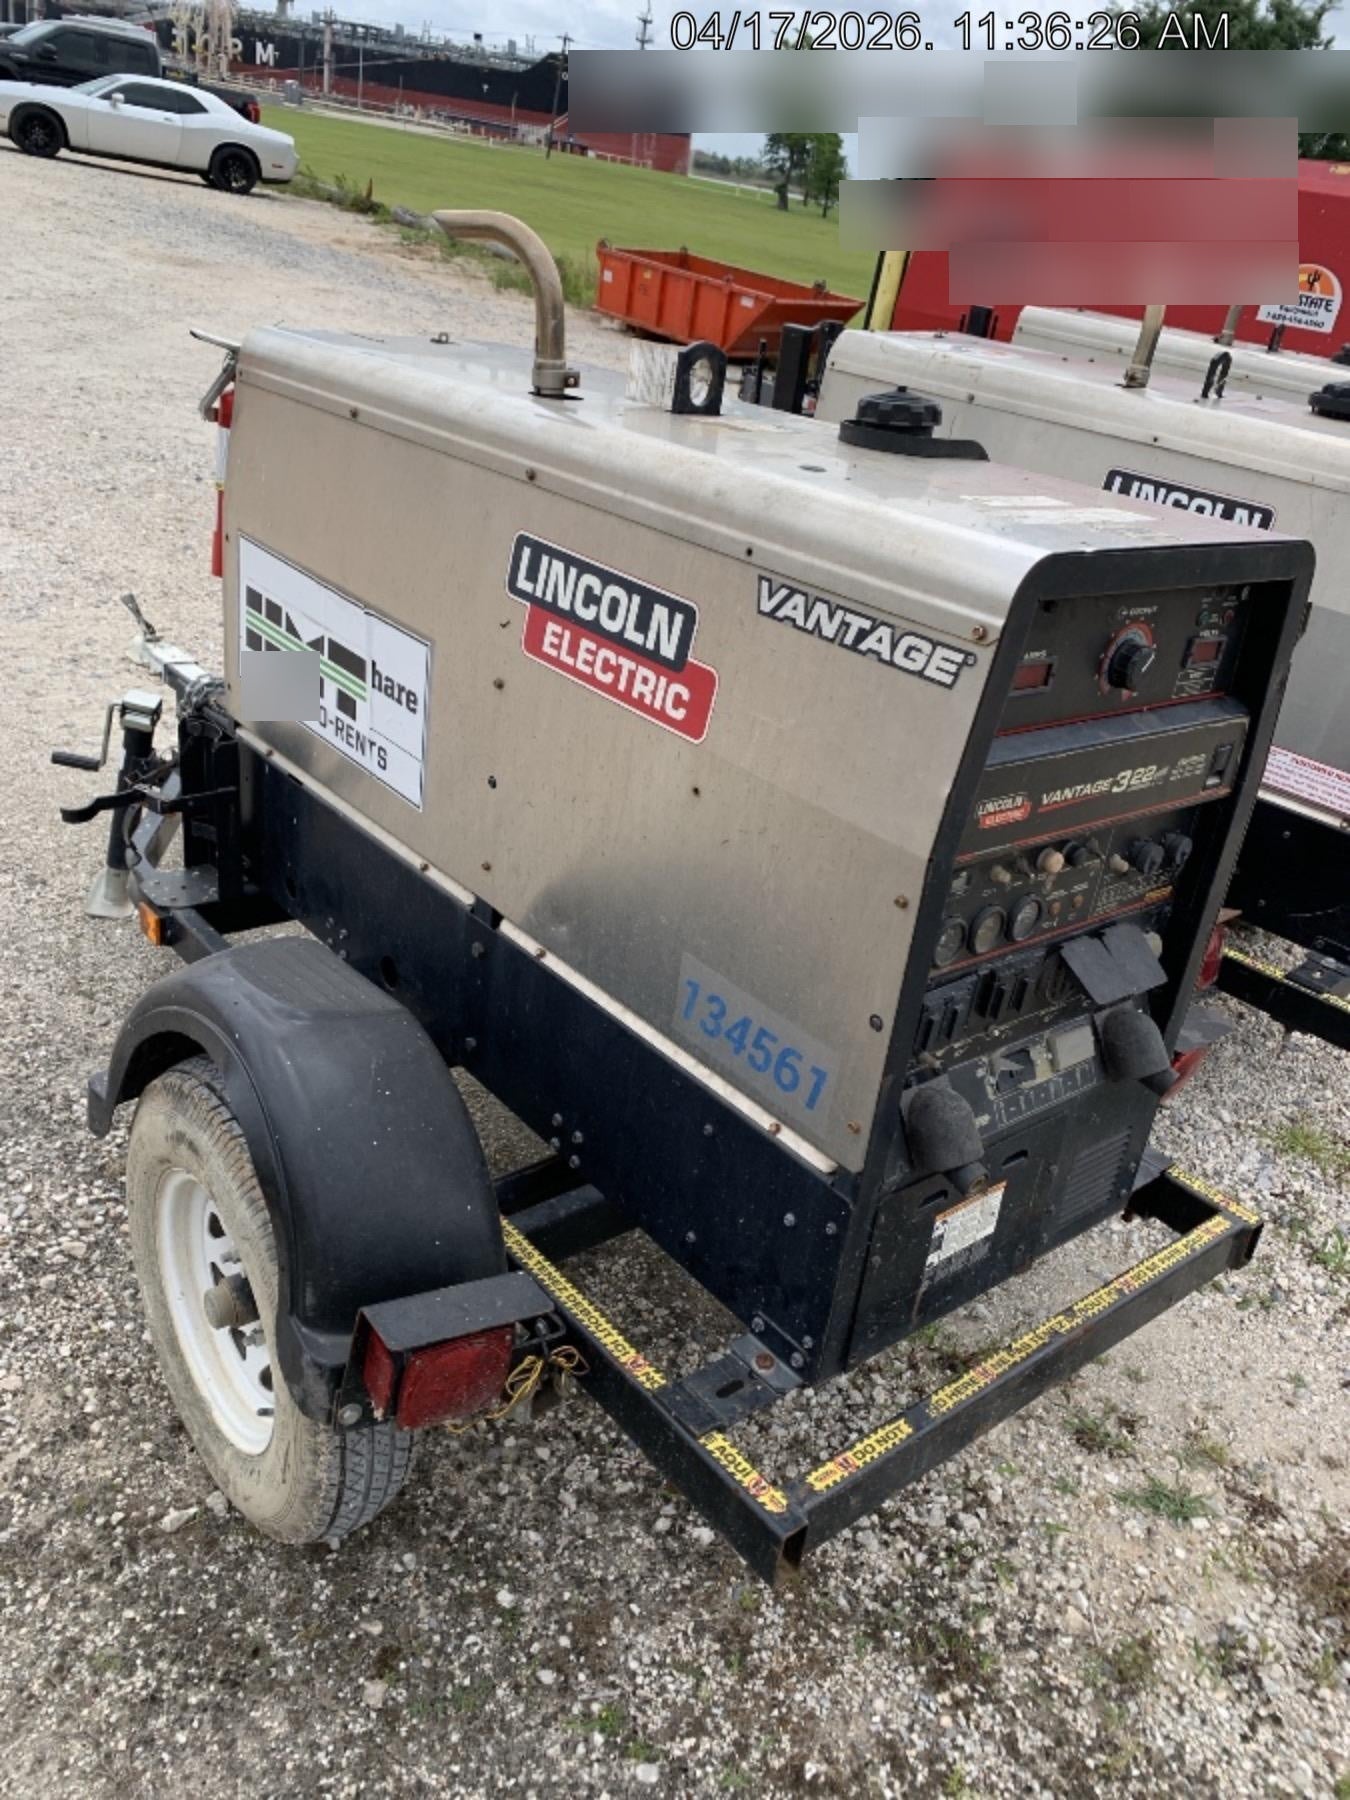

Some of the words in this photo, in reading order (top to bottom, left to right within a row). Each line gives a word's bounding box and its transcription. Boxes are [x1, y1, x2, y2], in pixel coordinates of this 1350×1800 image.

[515, 545, 685, 661] LINCOLN
[758, 574, 968, 690] VANTAGE
[541, 621, 691, 721] ELECTRIC
[977, 795, 1023, 815] LINCOLN
[1041, 776, 1113, 806] VANTAGE
[1111, 764, 1158, 793] 322
[682, 978, 829, 1110] 134561
[851, 1439, 877, 1462] DO
